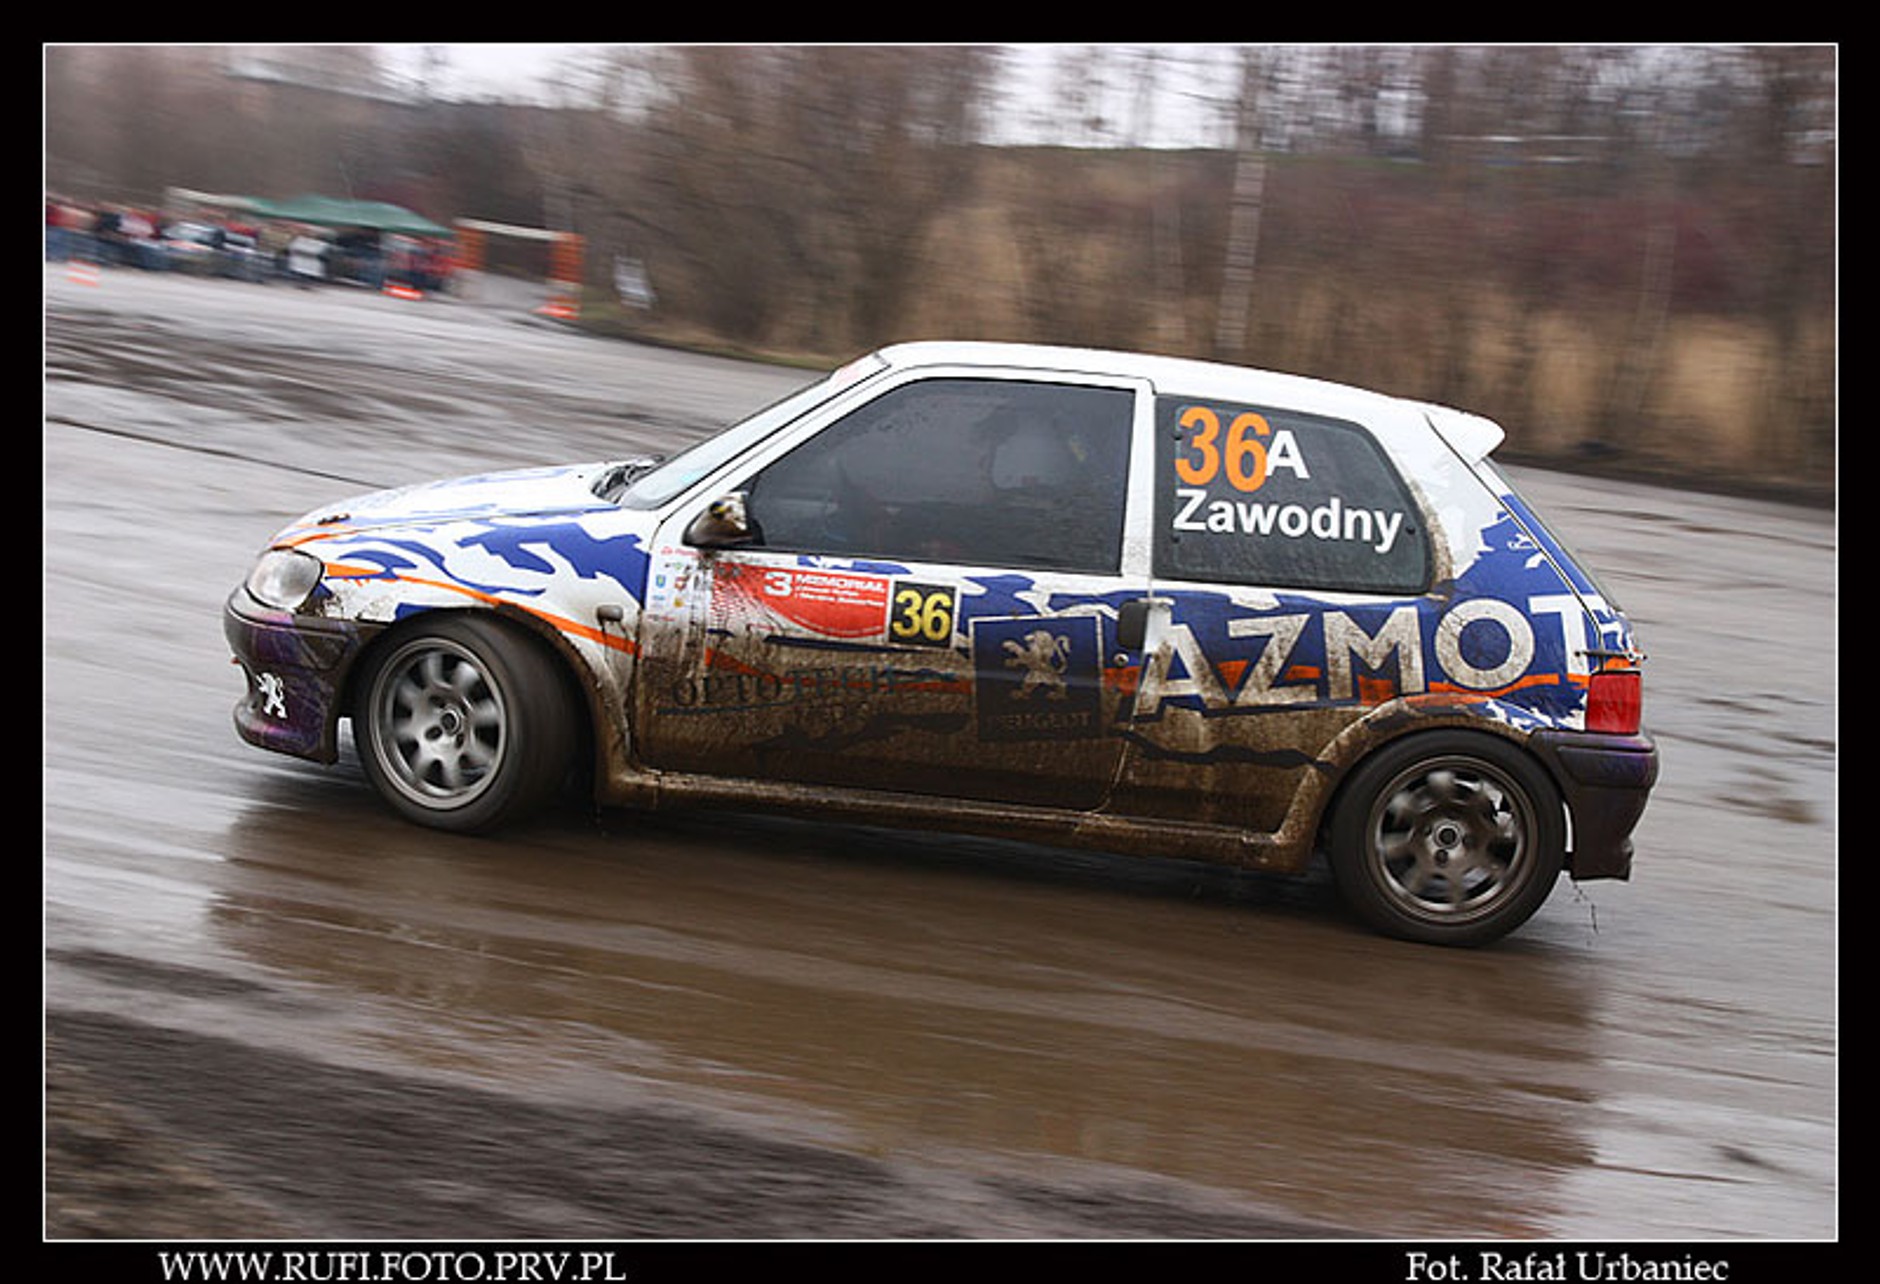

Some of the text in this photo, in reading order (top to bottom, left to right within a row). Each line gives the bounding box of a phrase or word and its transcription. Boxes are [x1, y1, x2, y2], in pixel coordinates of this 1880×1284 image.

[1175, 406, 1270, 493] 36
[1173, 489, 1403, 554] Zawodny
[764, 571, 792, 597] 3
[892, 589, 952, 642] 36
